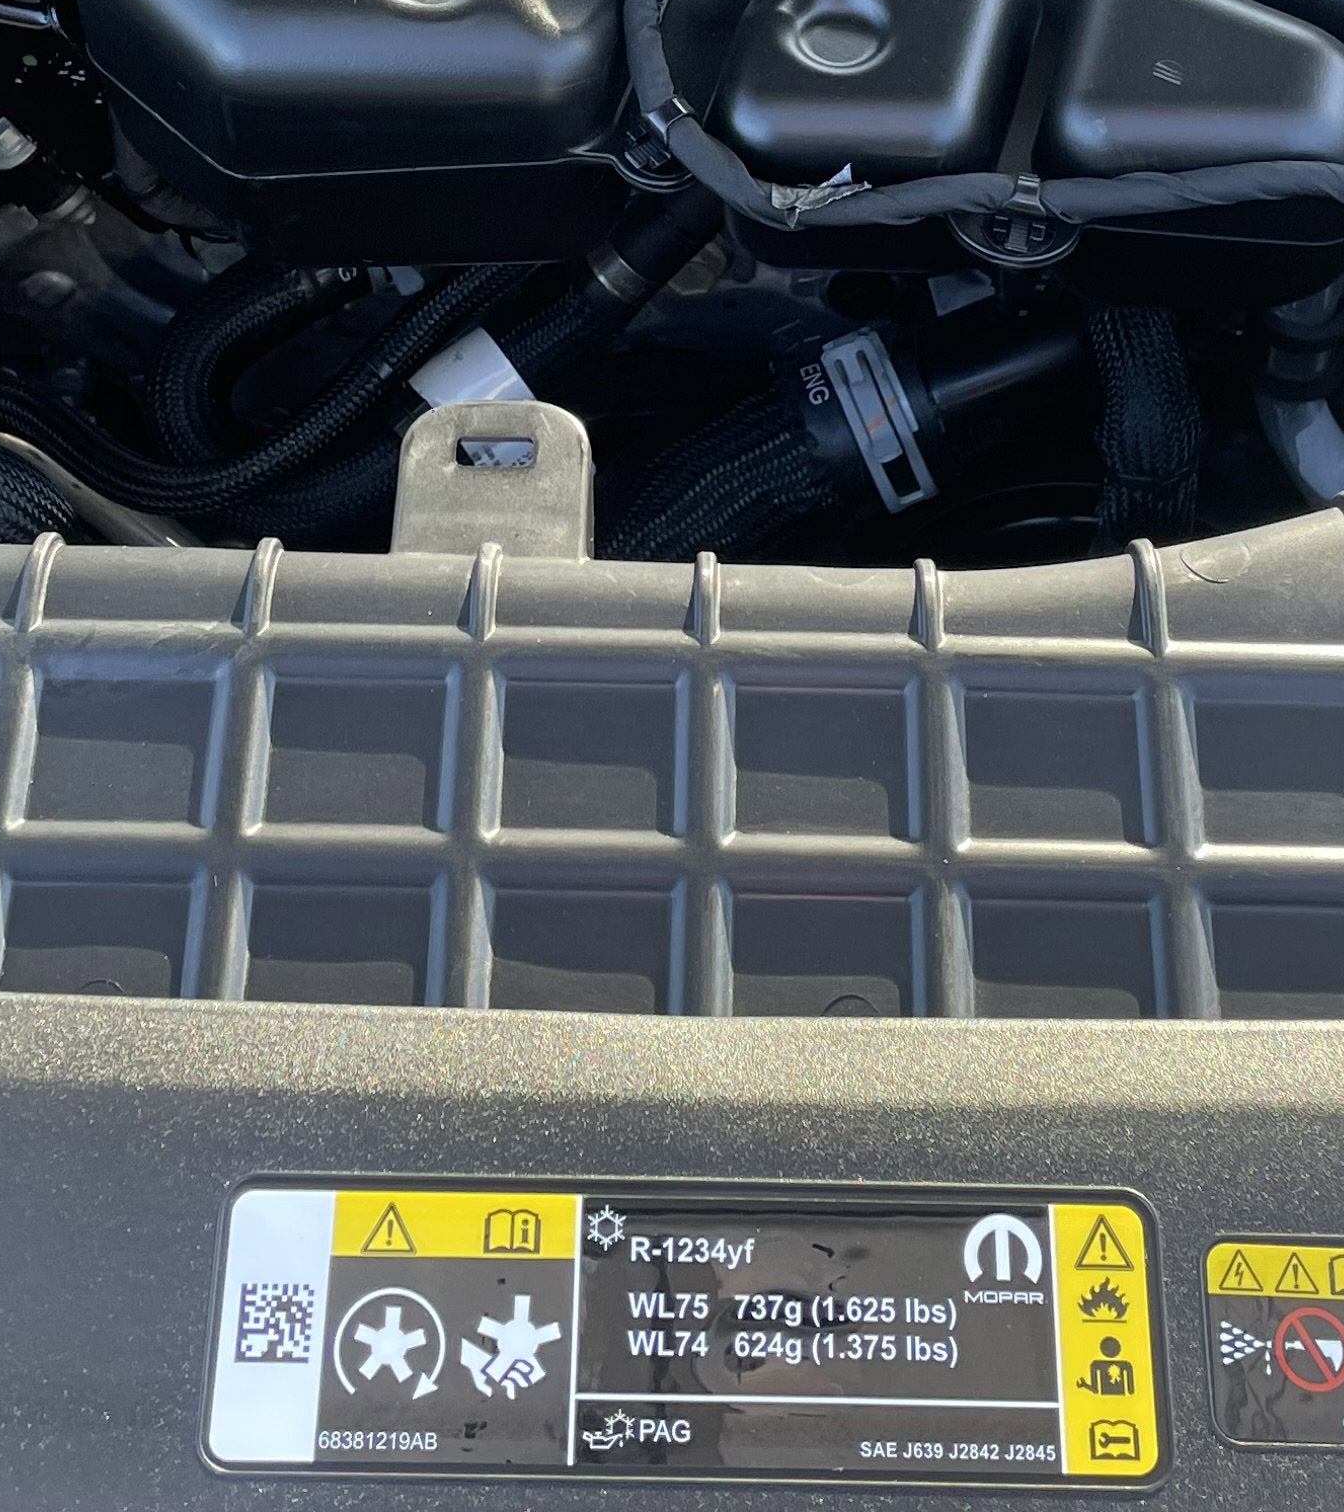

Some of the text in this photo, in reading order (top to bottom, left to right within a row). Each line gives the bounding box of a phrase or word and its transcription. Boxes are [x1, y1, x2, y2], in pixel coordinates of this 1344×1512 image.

[799, 363, 830, 406] ENG
[629, 1236, 755, 1270] R-1234yf
[628, 1292, 958, 1331] WL75 737g (1.625 lbs)
[964, 1290, 1044, 1305] MOPAR
[627, 1330, 958, 1368] WL74 624g (1.375 lbs)
[318, 1431, 438, 1451] 68381219AB
[638, 1419, 691, 1444] PAG
[859, 1441, 1056, 1462] SAE J639 J2842 J2845
